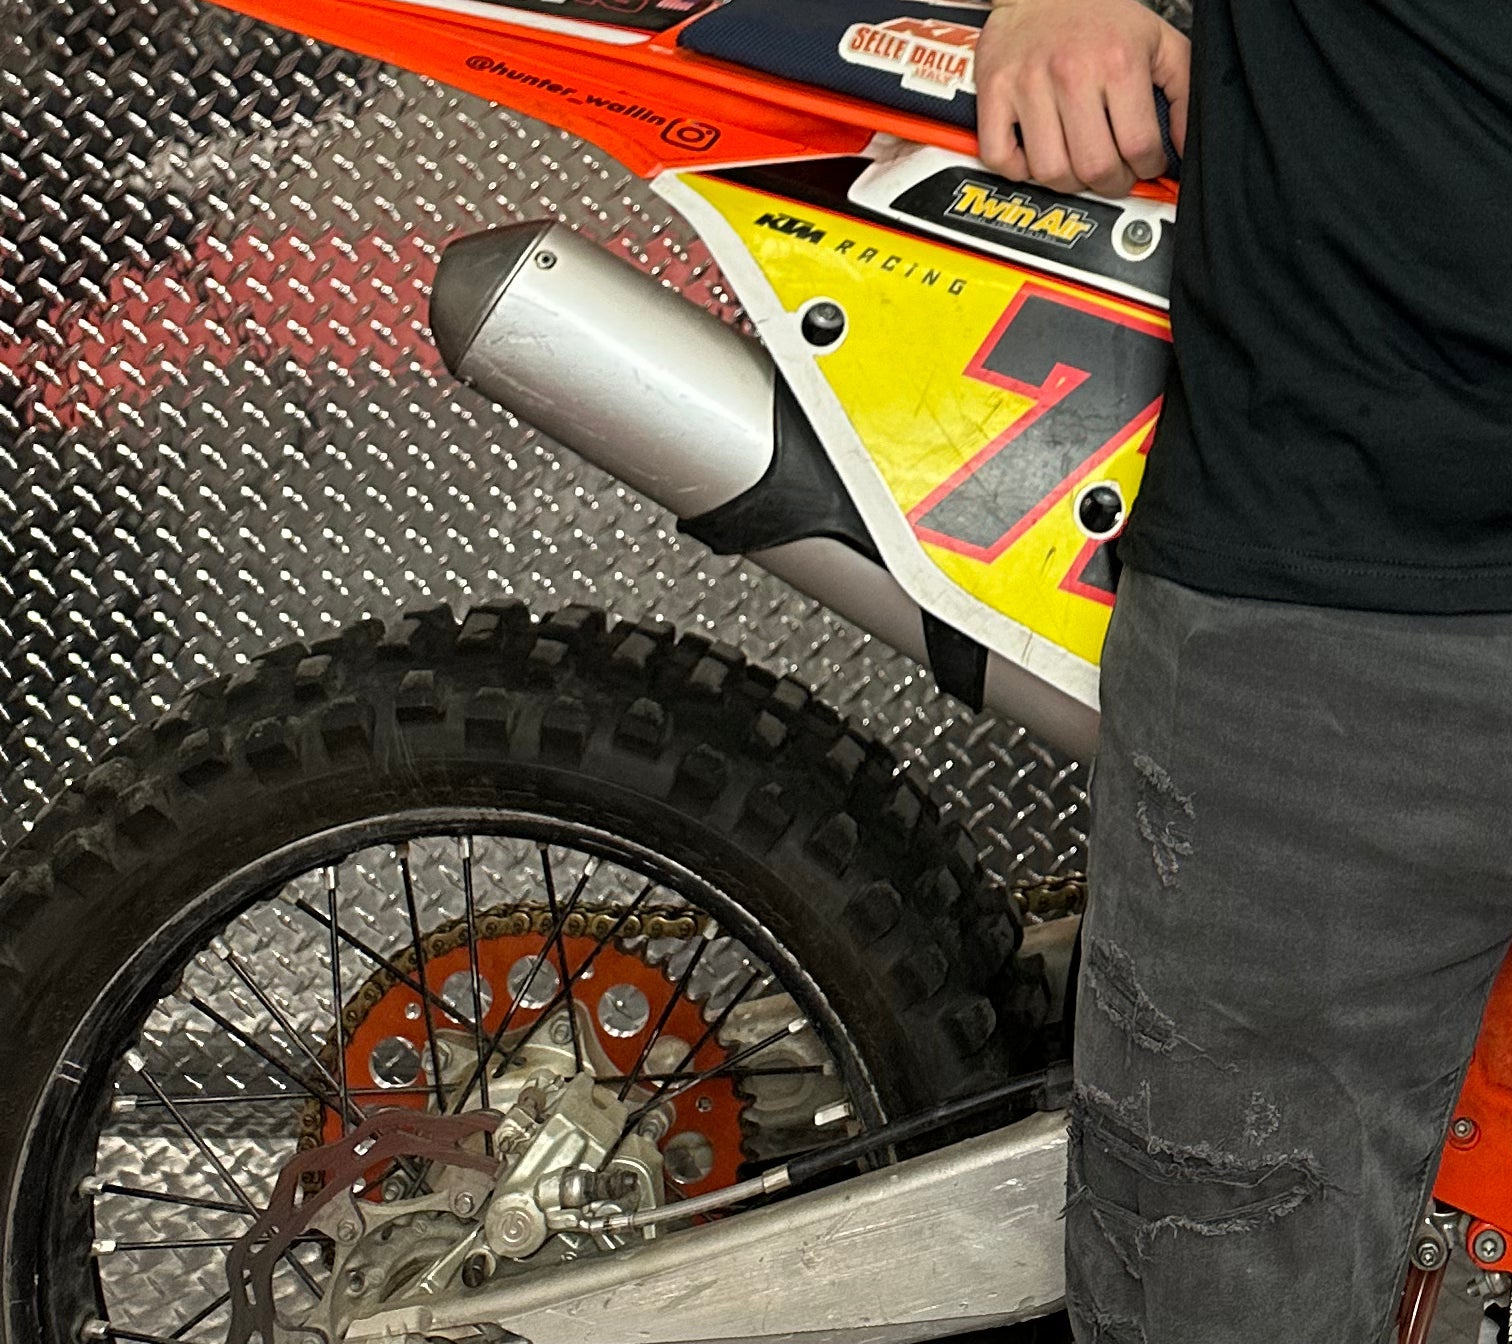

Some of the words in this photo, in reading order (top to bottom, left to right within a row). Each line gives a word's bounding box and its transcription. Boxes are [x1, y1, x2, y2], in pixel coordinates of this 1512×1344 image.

[851, 27, 908, 60] SELLE
[909, 45, 969, 78] DALLA
[465, 55, 667, 126] @hunter_wallin
[754, 212, 827, 244] KTM
[954, 184, 1037, 228] Twin
[1029, 208, 1093, 242] Air
